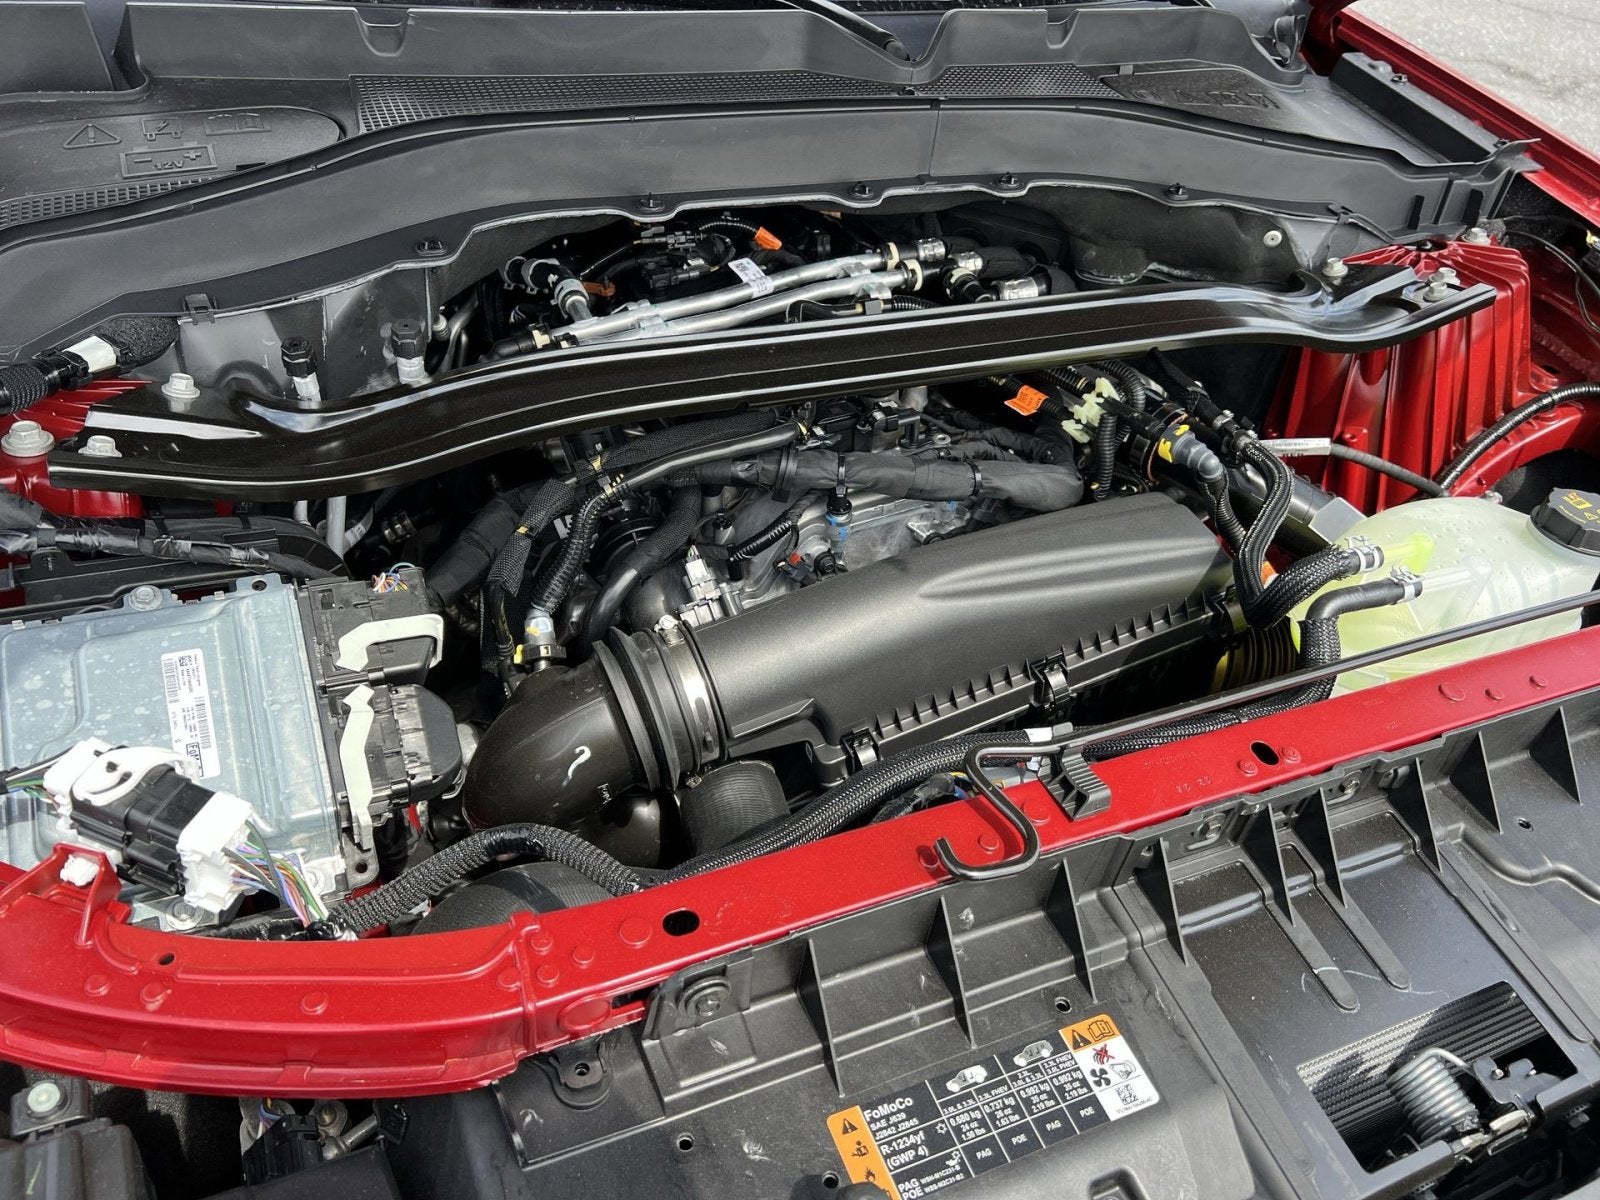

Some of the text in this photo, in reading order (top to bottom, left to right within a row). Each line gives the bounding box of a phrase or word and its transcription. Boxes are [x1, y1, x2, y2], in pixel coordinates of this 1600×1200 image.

[154, 160, 185, 170] 12V
[1052, 1070, 1083, 1086] 0.992 kg
[1020, 1082, 1050, 1098] 0.992 kg
[1064, 1090, 1078, 1100] 2.19
[864, 1098, 913, 1121] FoMoCo
[984, 1097, 1016, 1113] 0.737 kg
[1032, 1102, 1045, 1113] 2.19
[969, 1110, 982, 1119] kg
[1080, 1106, 1095, 1118] POE
[870, 1112, 906, 1131] SAE J639
[1046, 1120, 1062, 1131] PAG
[875, 1118, 919, 1140] J2842 J2845
[880, 1130, 925, 1156] R-1234yf
[1011, 1134, 1028, 1145] POE
[887, 1145, 929, 1170] (GWP 4)
[976, 1148, 992, 1159] PAG
[898, 1178, 919, 1192] PAG
[902, 1187, 924, 1200] POE
